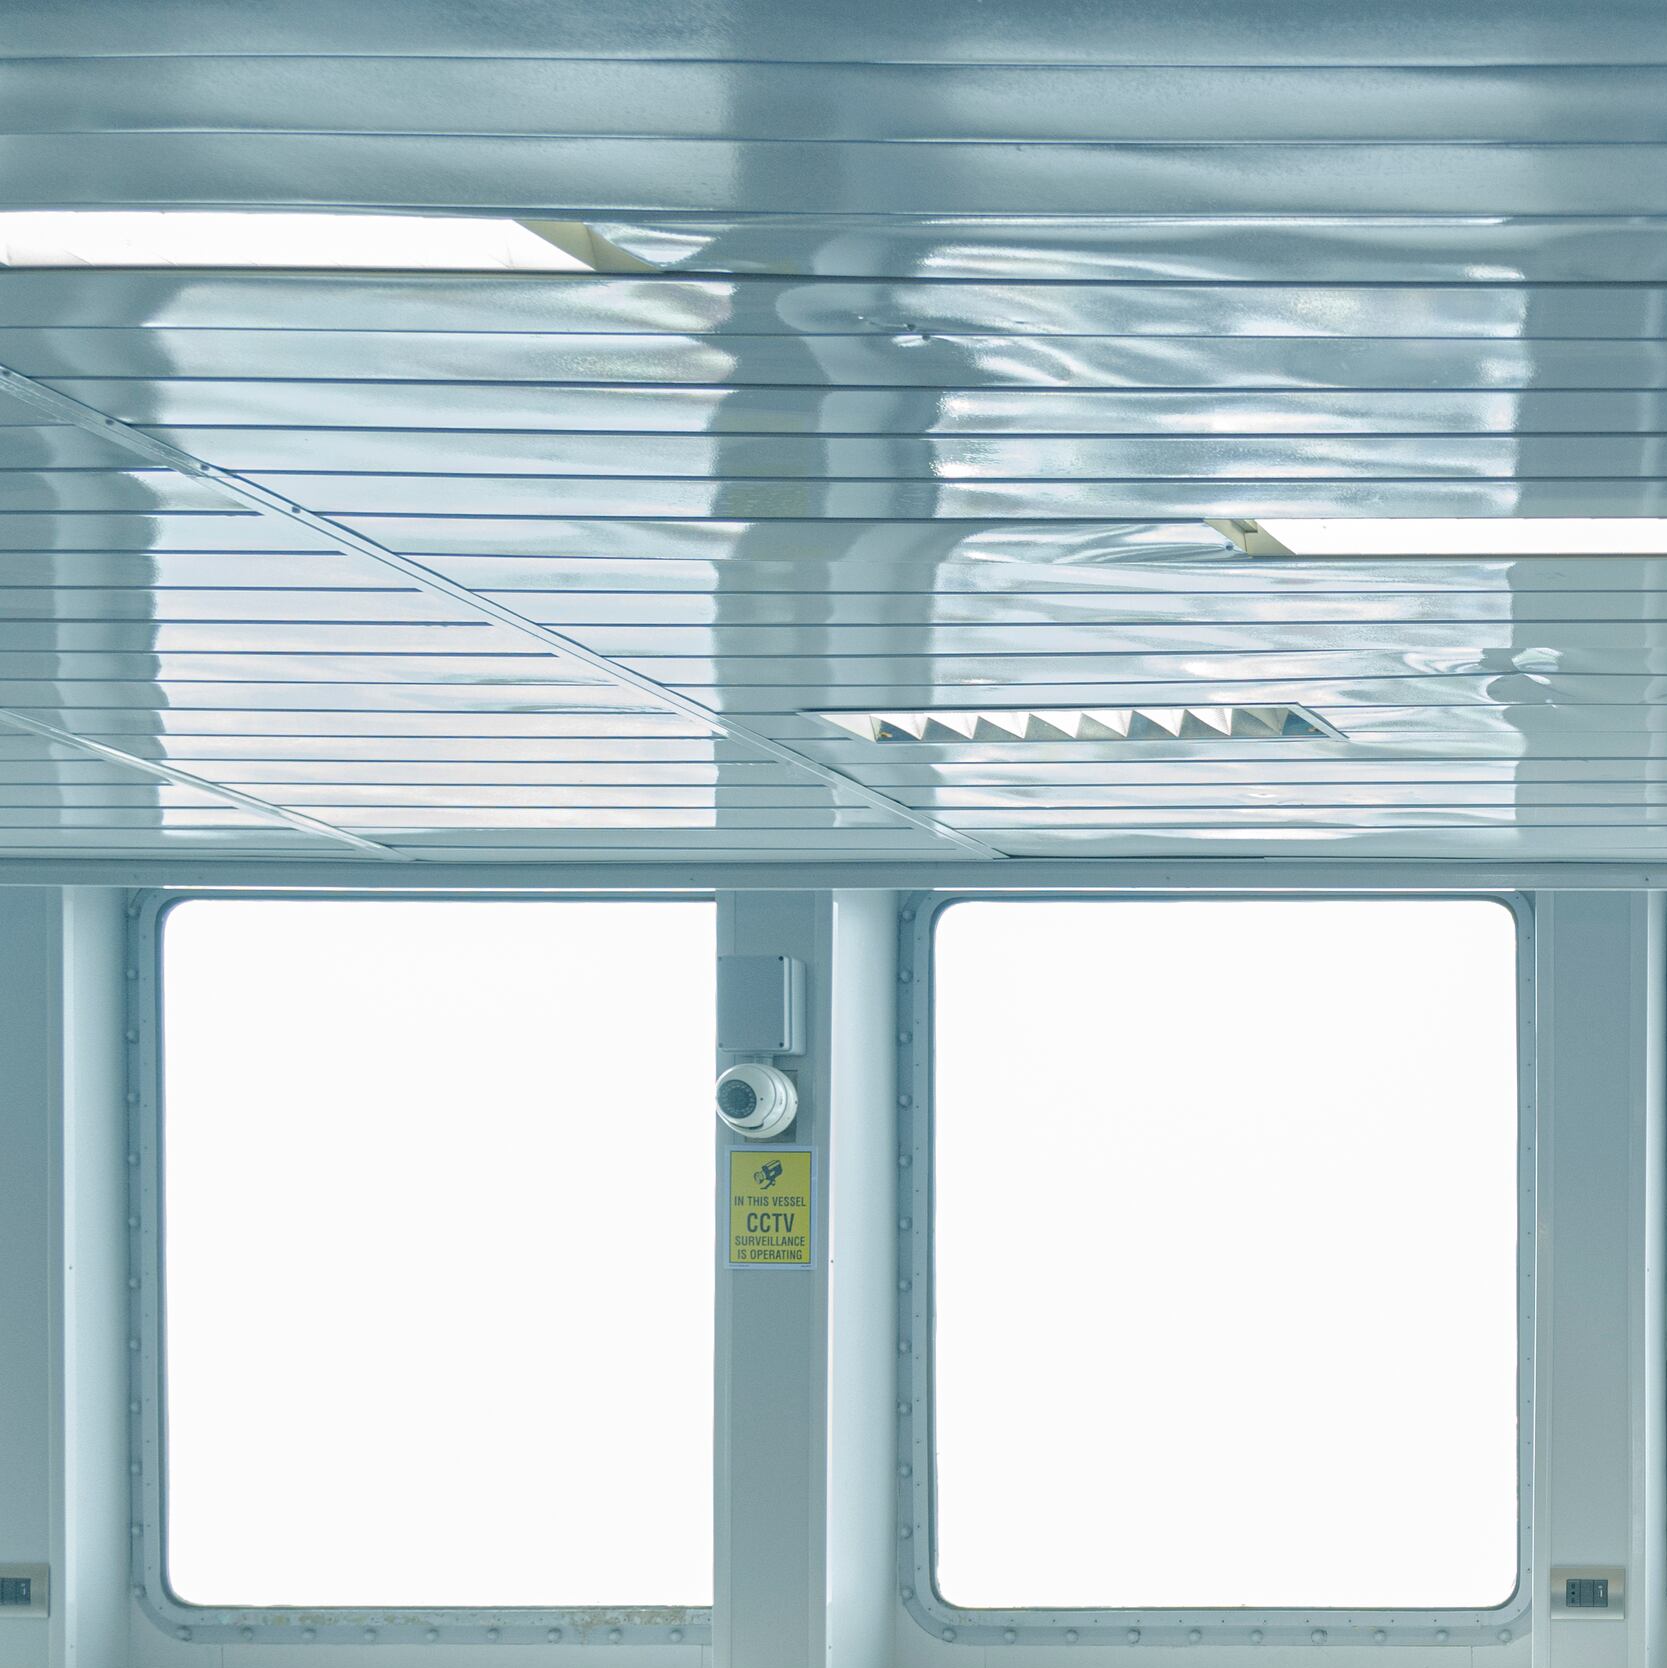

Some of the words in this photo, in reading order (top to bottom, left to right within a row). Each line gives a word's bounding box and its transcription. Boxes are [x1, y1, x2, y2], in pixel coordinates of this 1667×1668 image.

[734, 1196, 744, 1206] IN
[747, 1196, 769, 1206] THIS
[772, 1196, 806, 1207] VESSEL
[747, 1212, 795, 1233] CCTV
[735, 1236, 805, 1247] SURVEILLANCE
[737, 1249, 747, 1260] IS
[750, 1249, 802, 1260] OPERATING
